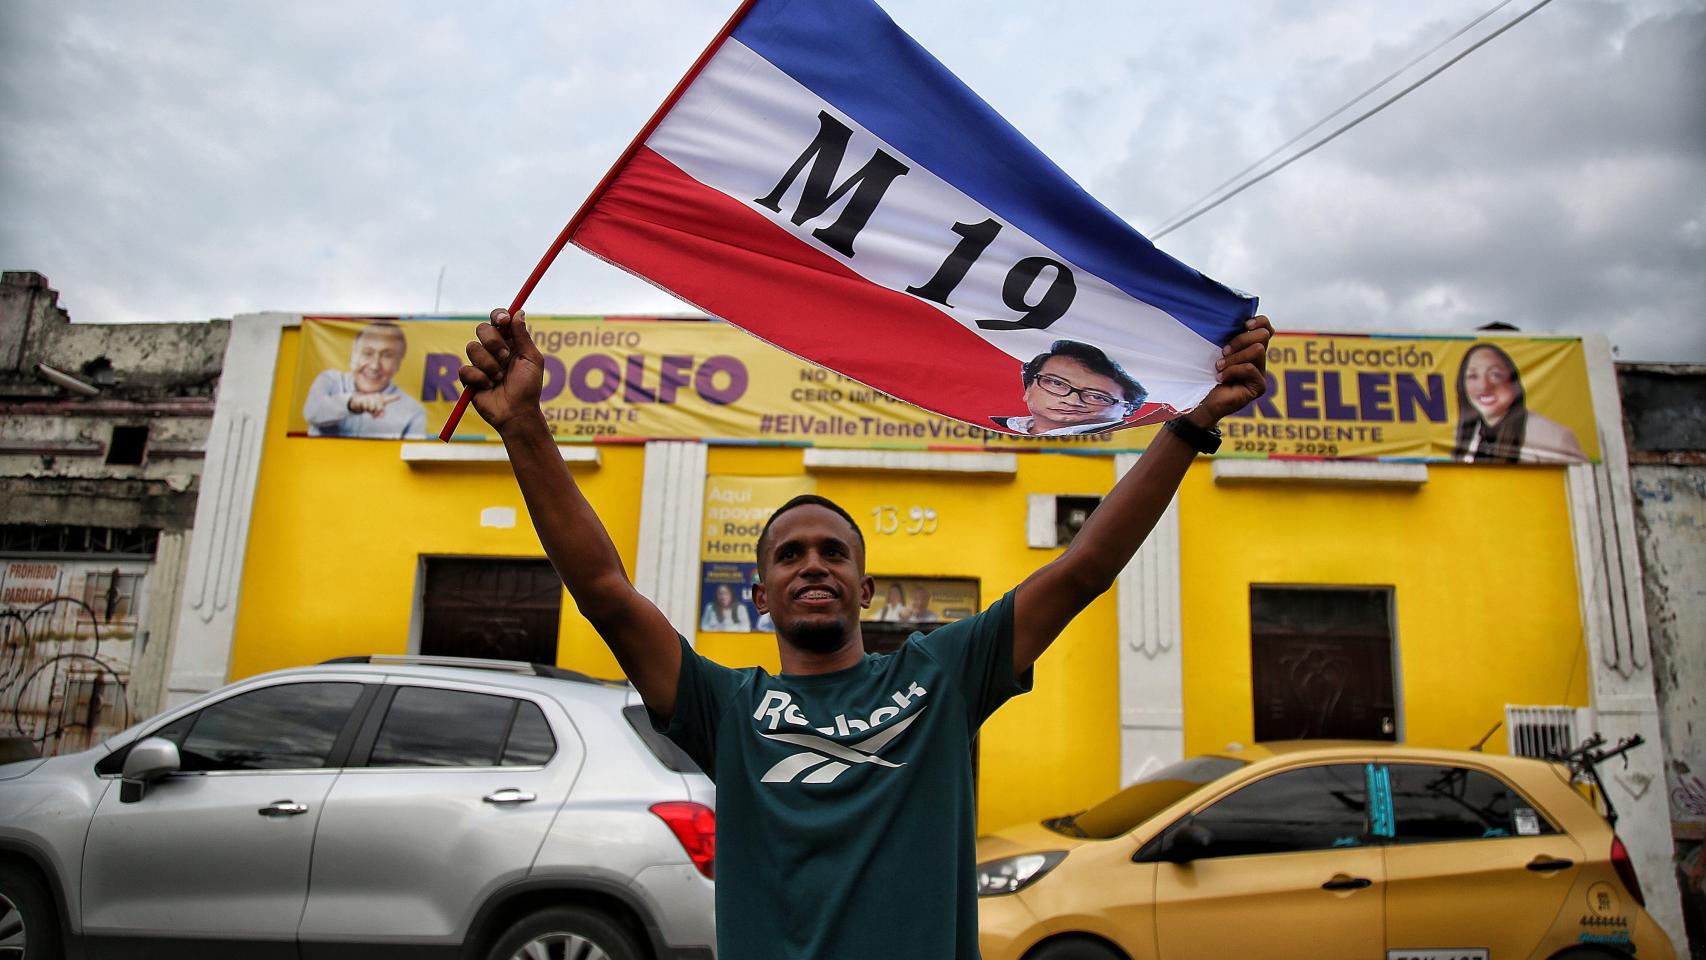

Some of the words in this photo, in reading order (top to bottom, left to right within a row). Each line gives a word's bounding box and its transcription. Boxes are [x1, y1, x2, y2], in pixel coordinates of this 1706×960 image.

[753, 109, 910, 259] M
[905, 217, 1077, 330] 19
[1267, 347, 1297, 364] en
[1305, 340, 1434, 367] Educación
[421, 352, 749, 405] RDOLFO
[800, 369, 827, 382] NO
[792, 388, 842, 402] CERO
[544, 407, 638, 423] SIDENTE
[1234, 441, 1277, 452] 2022
[9, 563, 57, 580] PROHIBIDO
[753, 681, 928, 736] Rebok
